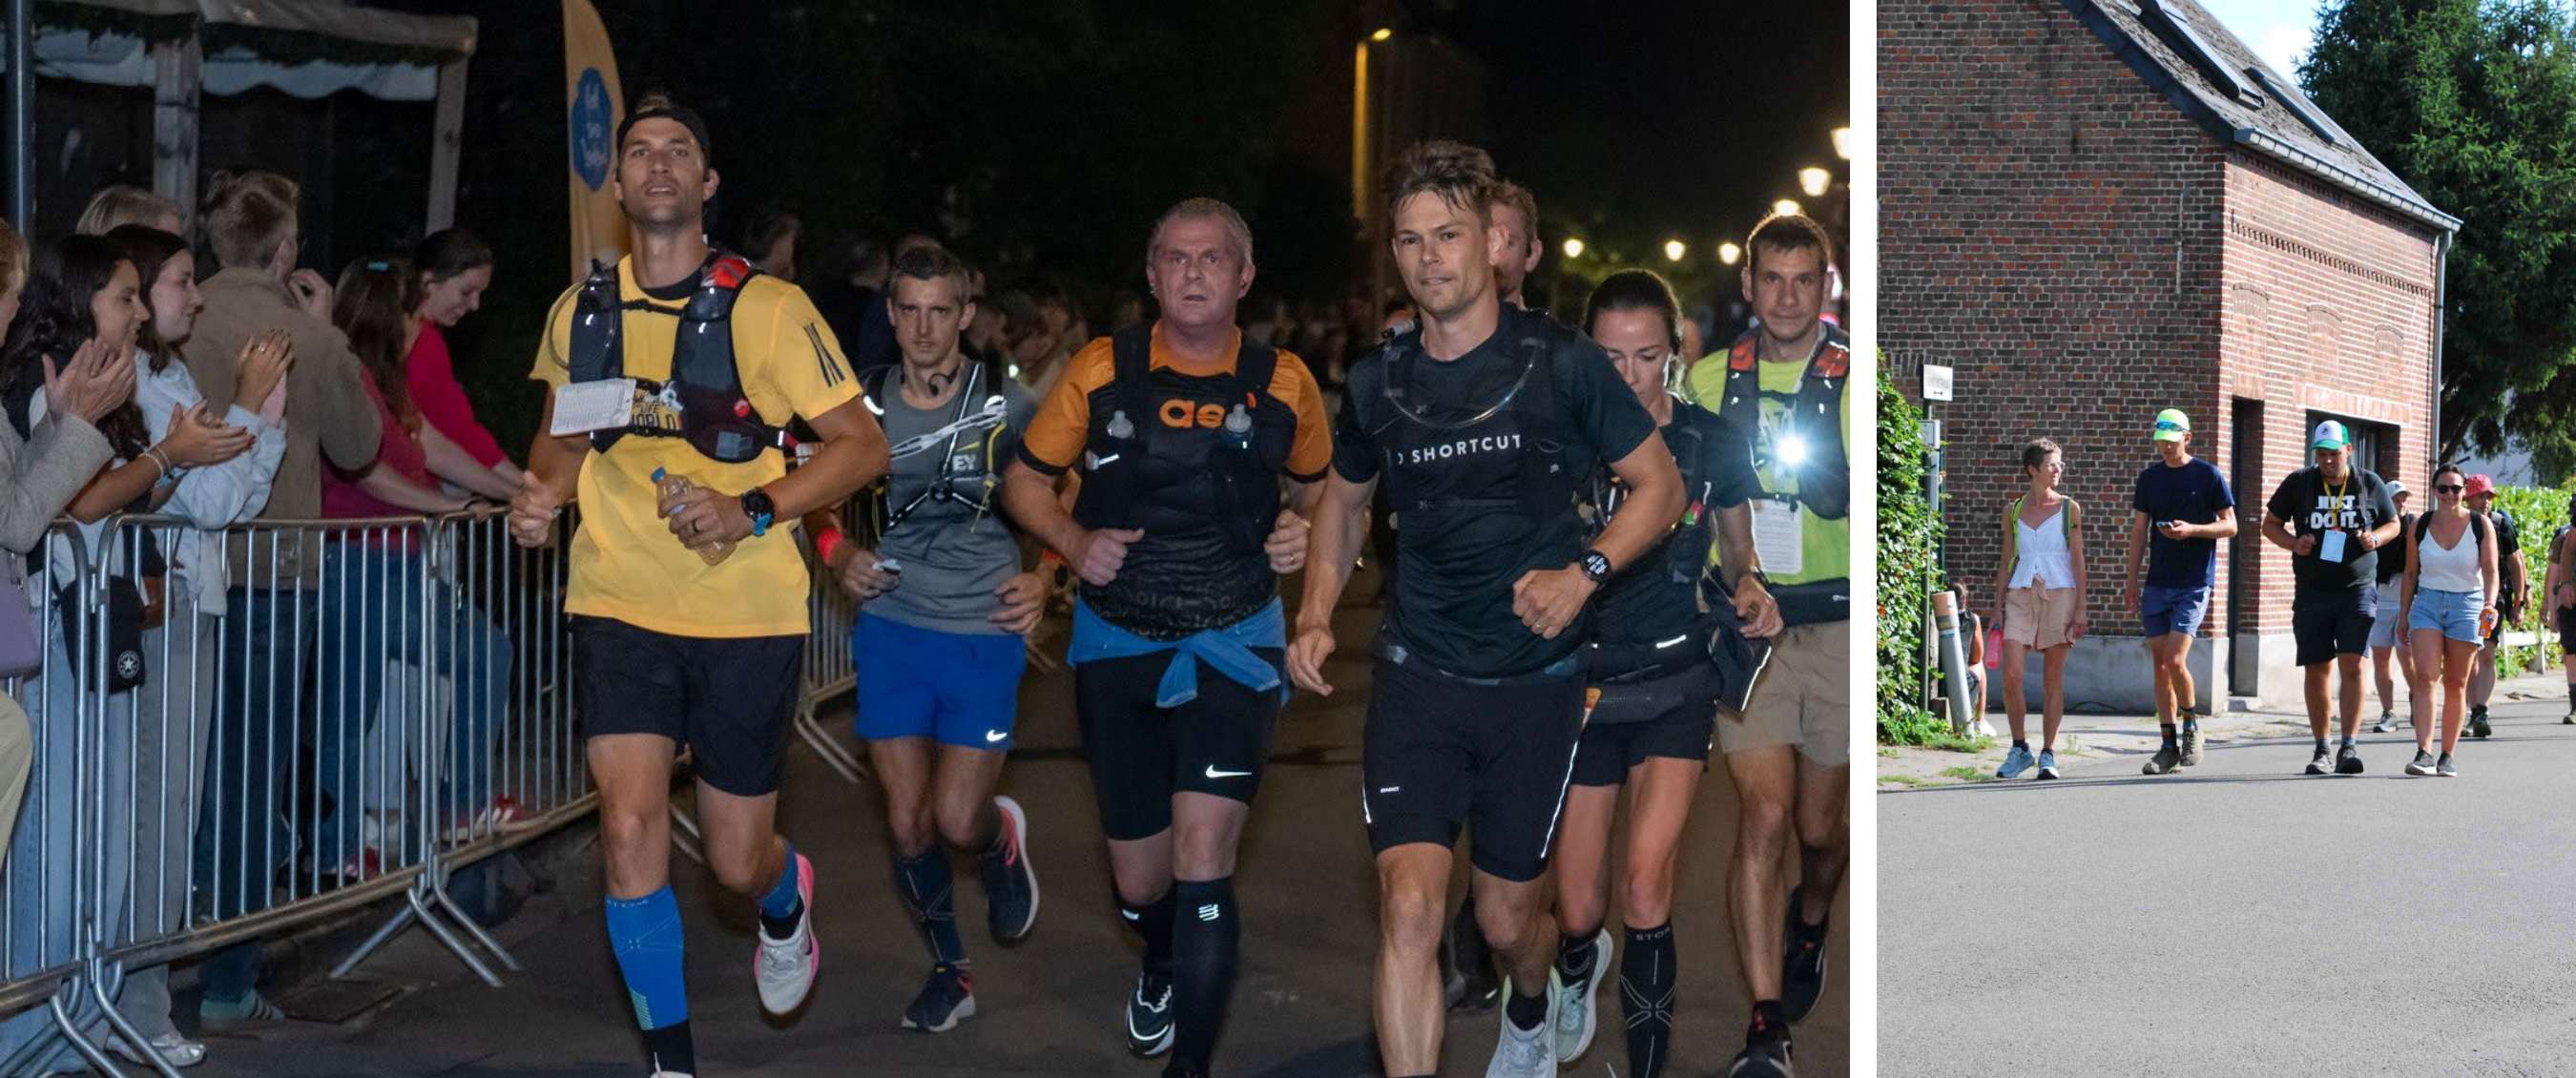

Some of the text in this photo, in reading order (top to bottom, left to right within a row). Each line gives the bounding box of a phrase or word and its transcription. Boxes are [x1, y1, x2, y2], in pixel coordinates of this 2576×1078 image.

[1159, 399, 1225, 427] as
[1412, 434, 1521, 464] SHORTCUT
[952, 454, 976, 470] EY
[2340, 510, 2358, 528] IT.
